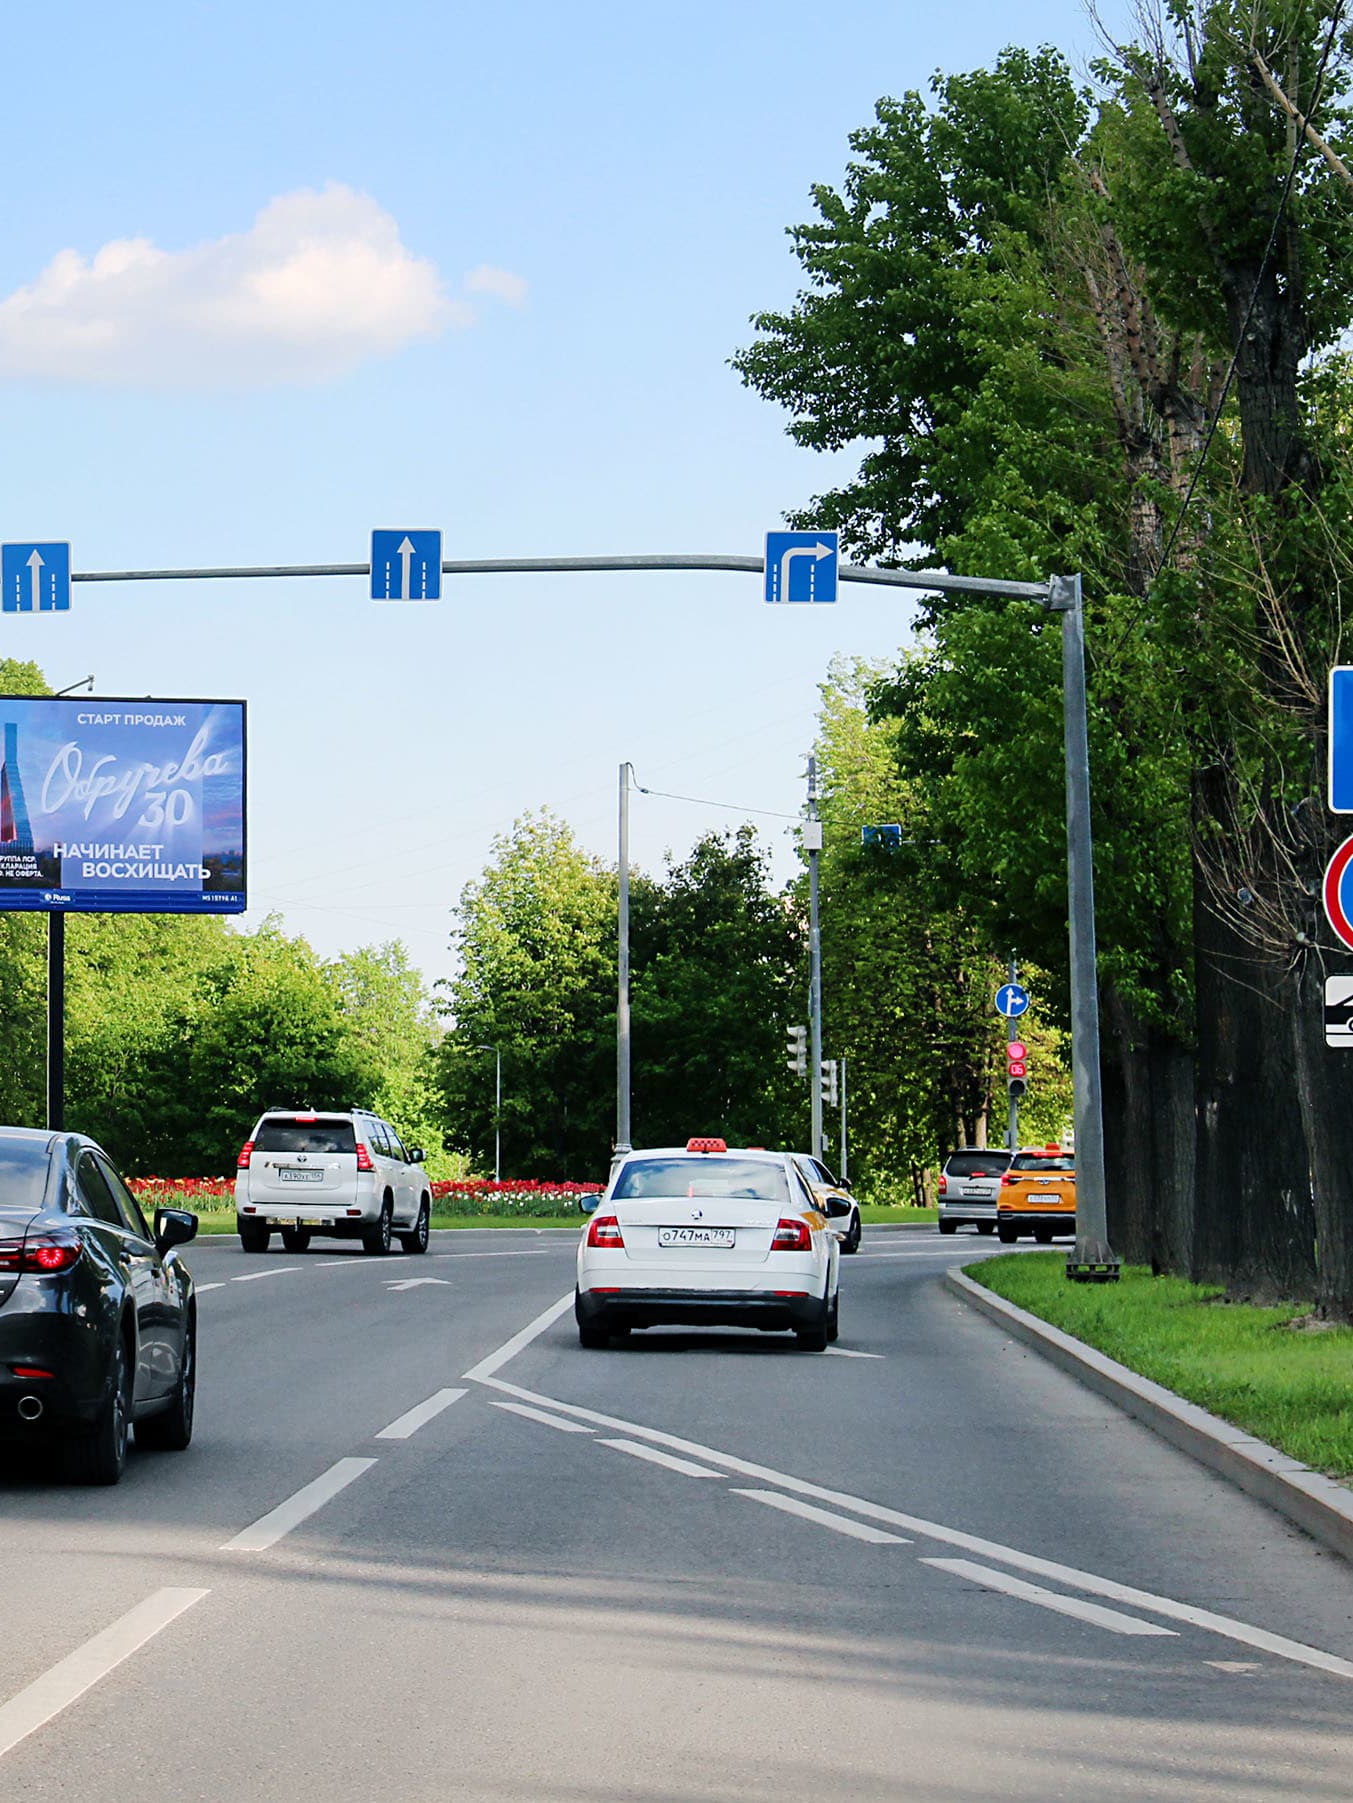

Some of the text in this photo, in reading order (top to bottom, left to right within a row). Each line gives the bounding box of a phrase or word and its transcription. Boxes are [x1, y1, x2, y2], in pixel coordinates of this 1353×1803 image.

[77, 713, 186, 727] СТАРТ ПРОДАЖ
[41, 726, 228, 822] Обручева
[138, 789, 193, 828] 30
[53, 843, 164, 860] НАЧИНАЕТ
[82, 862, 211, 882] ВОСХИЩАТЬ
[712, 1230, 732, 1241] 797
